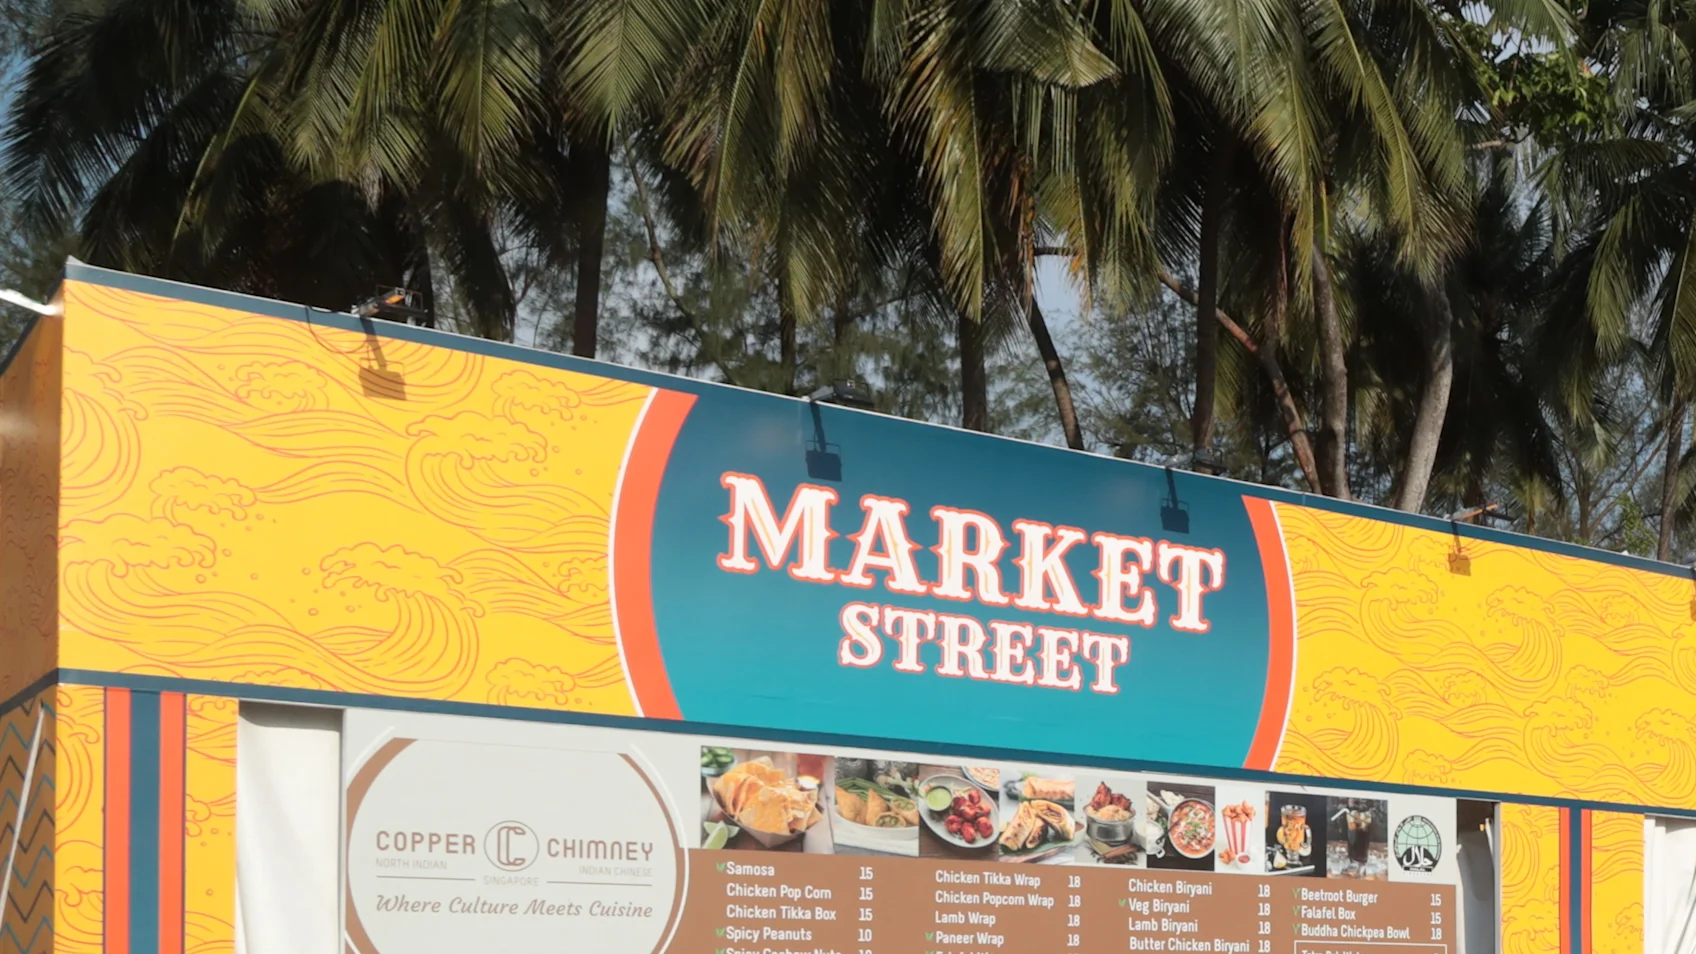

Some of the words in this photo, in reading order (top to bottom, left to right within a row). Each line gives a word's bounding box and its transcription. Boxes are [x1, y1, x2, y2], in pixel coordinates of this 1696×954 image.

[717, 471, 1226, 632] MARKET
[838, 601, 1130, 694] STREET
[376, 830, 476, 854] COPPER
[547, 838, 653, 861] CHIMNEY
[376, 858, 409, 869] NORTH
[412, 859, 447, 870] INDIAN
[579, 865, 611, 876] INDIAN
[614, 866, 653, 877] CHINESE
[726, 861, 775, 876] Samosa
[859, 866, 873, 879] 15
[935, 869, 980, 884] Chicken
[982, 871, 1011, 885] Tikka
[1014, 873, 1041, 889] Wrap
[483, 875, 539, 887] SINGAPORE
[1068, 875, 1081, 888] 18
[1128, 878, 1173, 894] Chicken
[1176, 880, 1212, 898] Biryani
[726, 883, 776, 897] Chicken
[780, 885, 801, 901] Pop
[805, 885, 831, 899] Corn
[859, 887, 873, 900] 15
[1257, 884, 1271, 898] 18
[1301, 887, 1344, 902] Beetroot
[1346, 889, 1378, 906] Burger
[376, 894, 441, 913] Where
[449, 896, 519, 915] Culture
[523, 898, 582, 917] Meets
[589, 900, 652, 918] Cuisine
[935, 890, 980, 904] Chicken
[983, 892, 1025, 908] Popcorn
[1028, 893, 1054, 910] Wrap
[1068, 895, 1081, 908] 18
[1128, 898, 1150, 915] Veg
[1152, 899, 1190, 915] Biryani
[1430, 893, 1441, 906] 15
[726, 904, 776, 919] Chicken
[780, 905, 811, 920] Tikka
[815, 907, 836, 920] Box
[858, 908, 873, 921] 15
[1258, 903, 1271, 916] 18
[1301, 905, 1336, 920] Falafel
[1338, 907, 1356, 920] Box
[935, 911, 965, 924] Lamb
[968, 911, 996, 928] Wrap
[1067, 914, 1080, 927] 18
[1128, 917, 1158, 931] Lamb
[1161, 918, 1198, 935] Biryani
[1430, 912, 1441, 925] 15
[726, 926, 760, 943] Spicy
[763, 926, 812, 941] Peanuts
[858, 928, 872, 942] 10
[1258, 921, 1271, 935] 18
[1301, 923, 1338, 937] Buddha
[1340, 925, 1384, 941] Chickpea
[1387, 926, 1410, 940] Bowl
[1430, 927, 1442, 940] 18
[936, 931, 974, 945] Paneer
[976, 932, 1004, 947] Wrap
[1067, 934, 1080, 947] 18
[1129, 936, 1165, 950] Butter
[1167, 937, 1211, 952] Chicken
[1214, 938, 1250, 954] Biryani
[1257, 939, 1271, 953] 18
